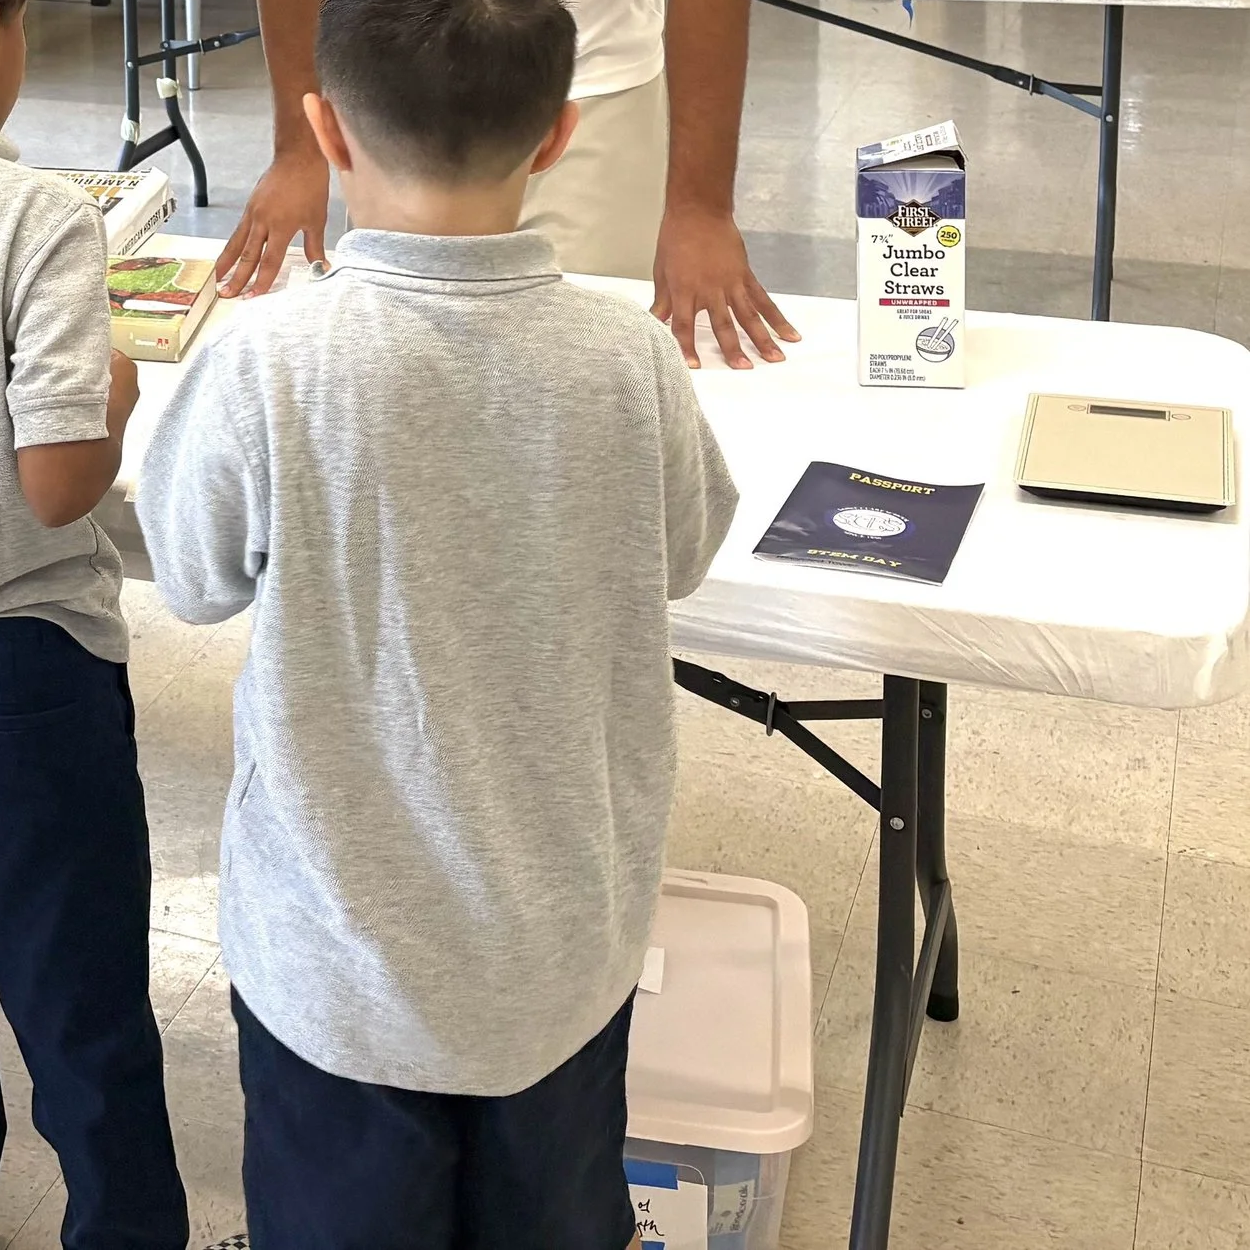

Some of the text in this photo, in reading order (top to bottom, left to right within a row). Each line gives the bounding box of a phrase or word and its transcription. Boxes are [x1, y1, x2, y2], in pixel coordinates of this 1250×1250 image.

[897, 205, 931, 217] FIRST
[892, 216, 936, 228] STREET
[939, 230, 958, 240] 250
[882, 244, 946, 260] Jumbo
[890, 261, 939, 277] Clear
[884, 280, 945, 295] Straws
[849, 472, 936, 496] PASSPORT
[807, 549, 859, 560] STEM
[862, 555, 902, 568] DAY
